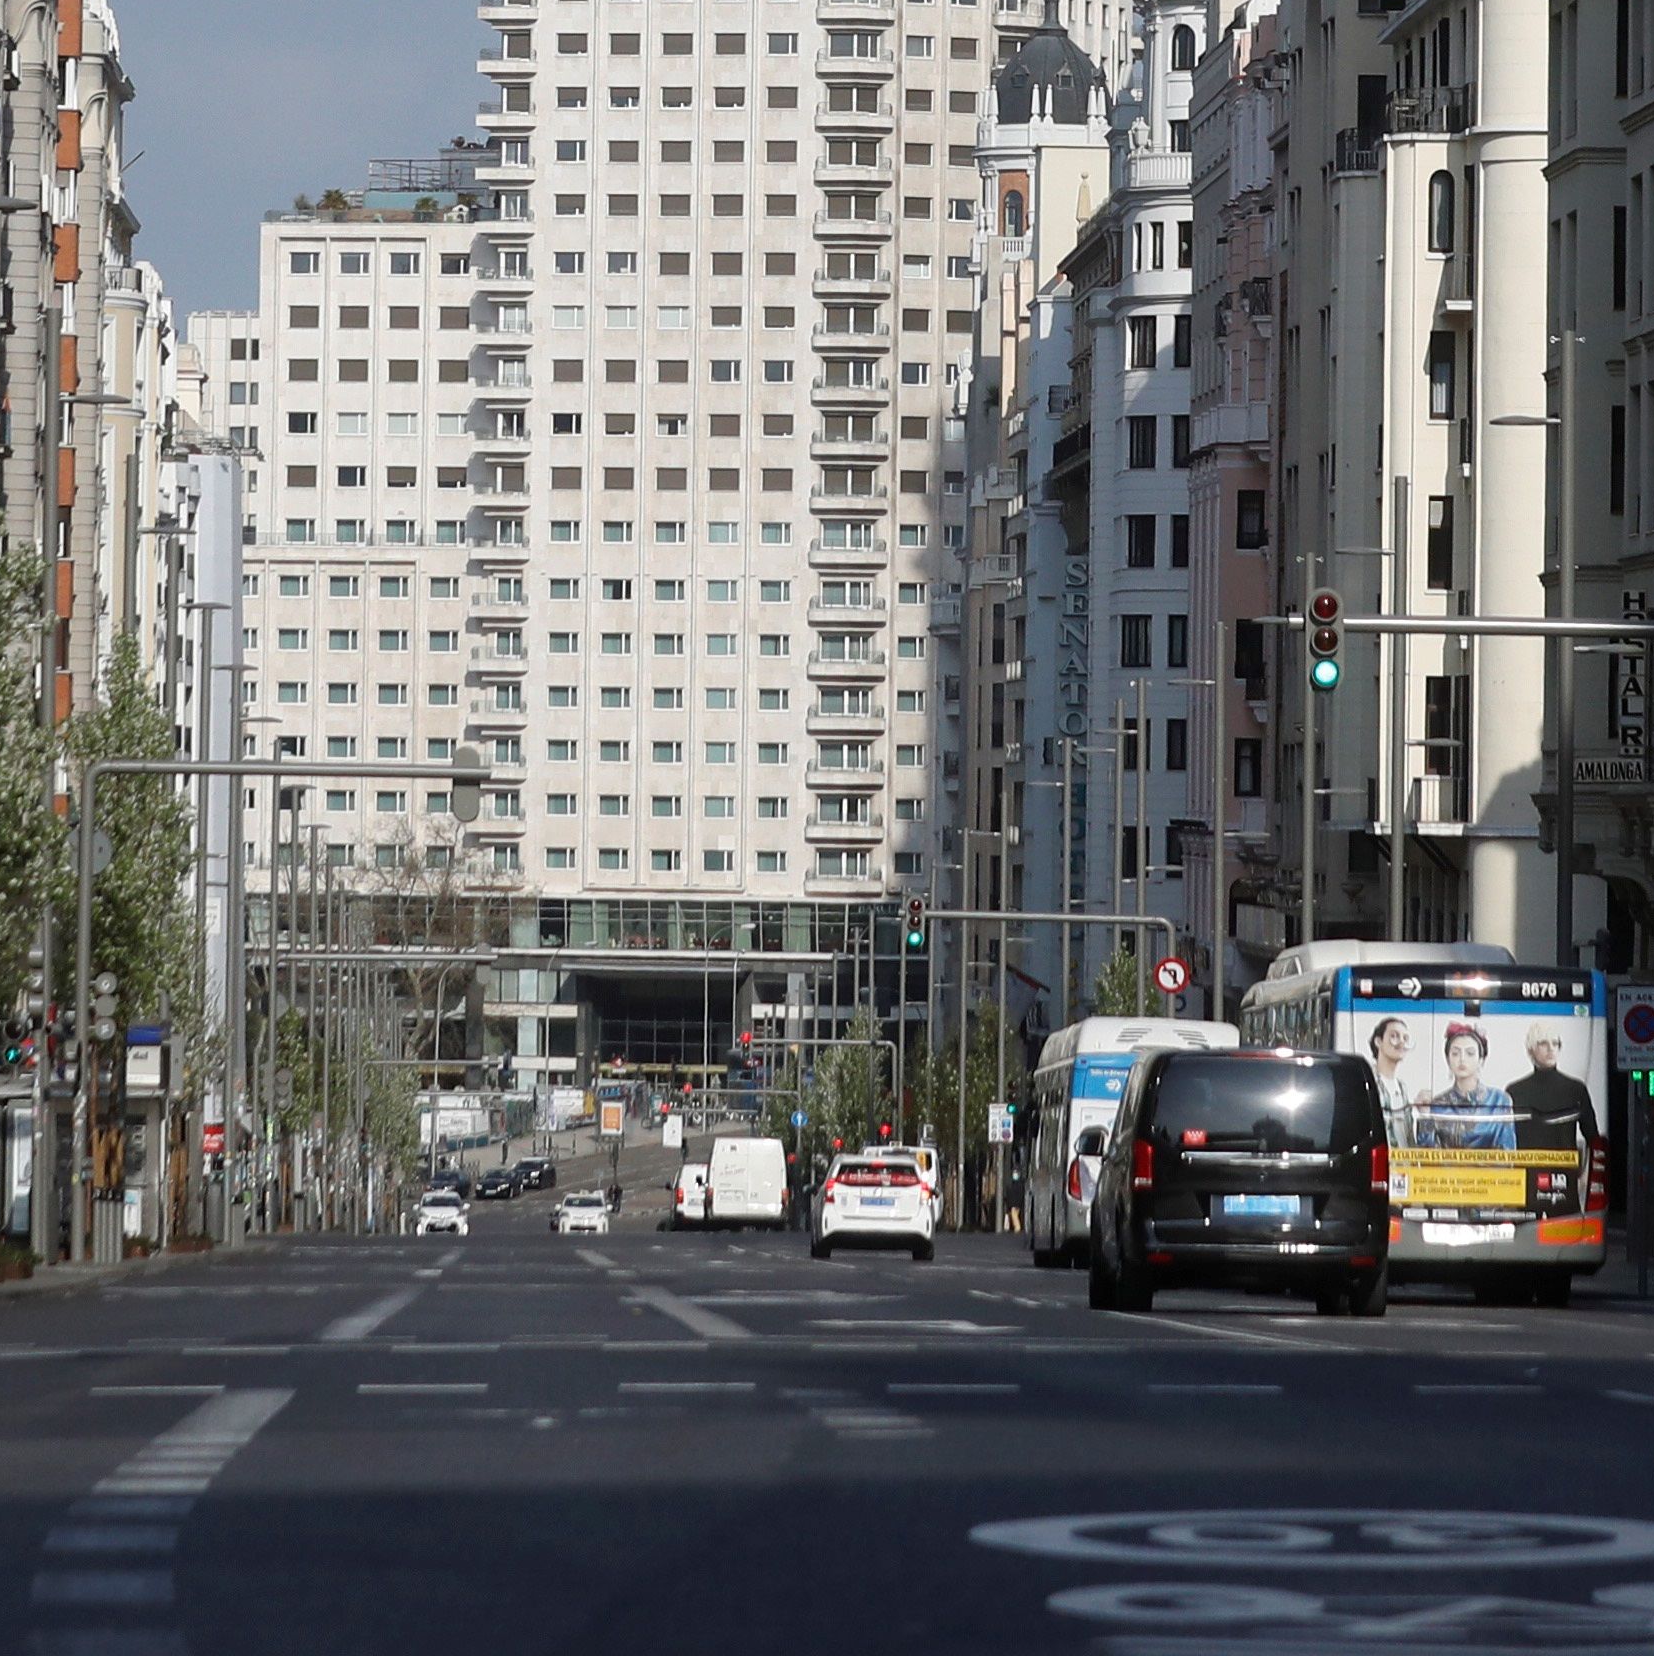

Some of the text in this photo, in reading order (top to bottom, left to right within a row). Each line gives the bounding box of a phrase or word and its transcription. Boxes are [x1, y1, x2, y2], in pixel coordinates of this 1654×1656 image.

[1058, 561, 1090, 766] SENATOR
[1576, 762, 1643, 782] AMALONGA
[1521, 982, 1557, 998] 8676
[1398, 1149, 1430, 1162] CULTURA
[1459, 1150, 1506, 1162] EXPERIENCIA
[1507, 1150, 1576, 1163] TRANSFORMADORA
